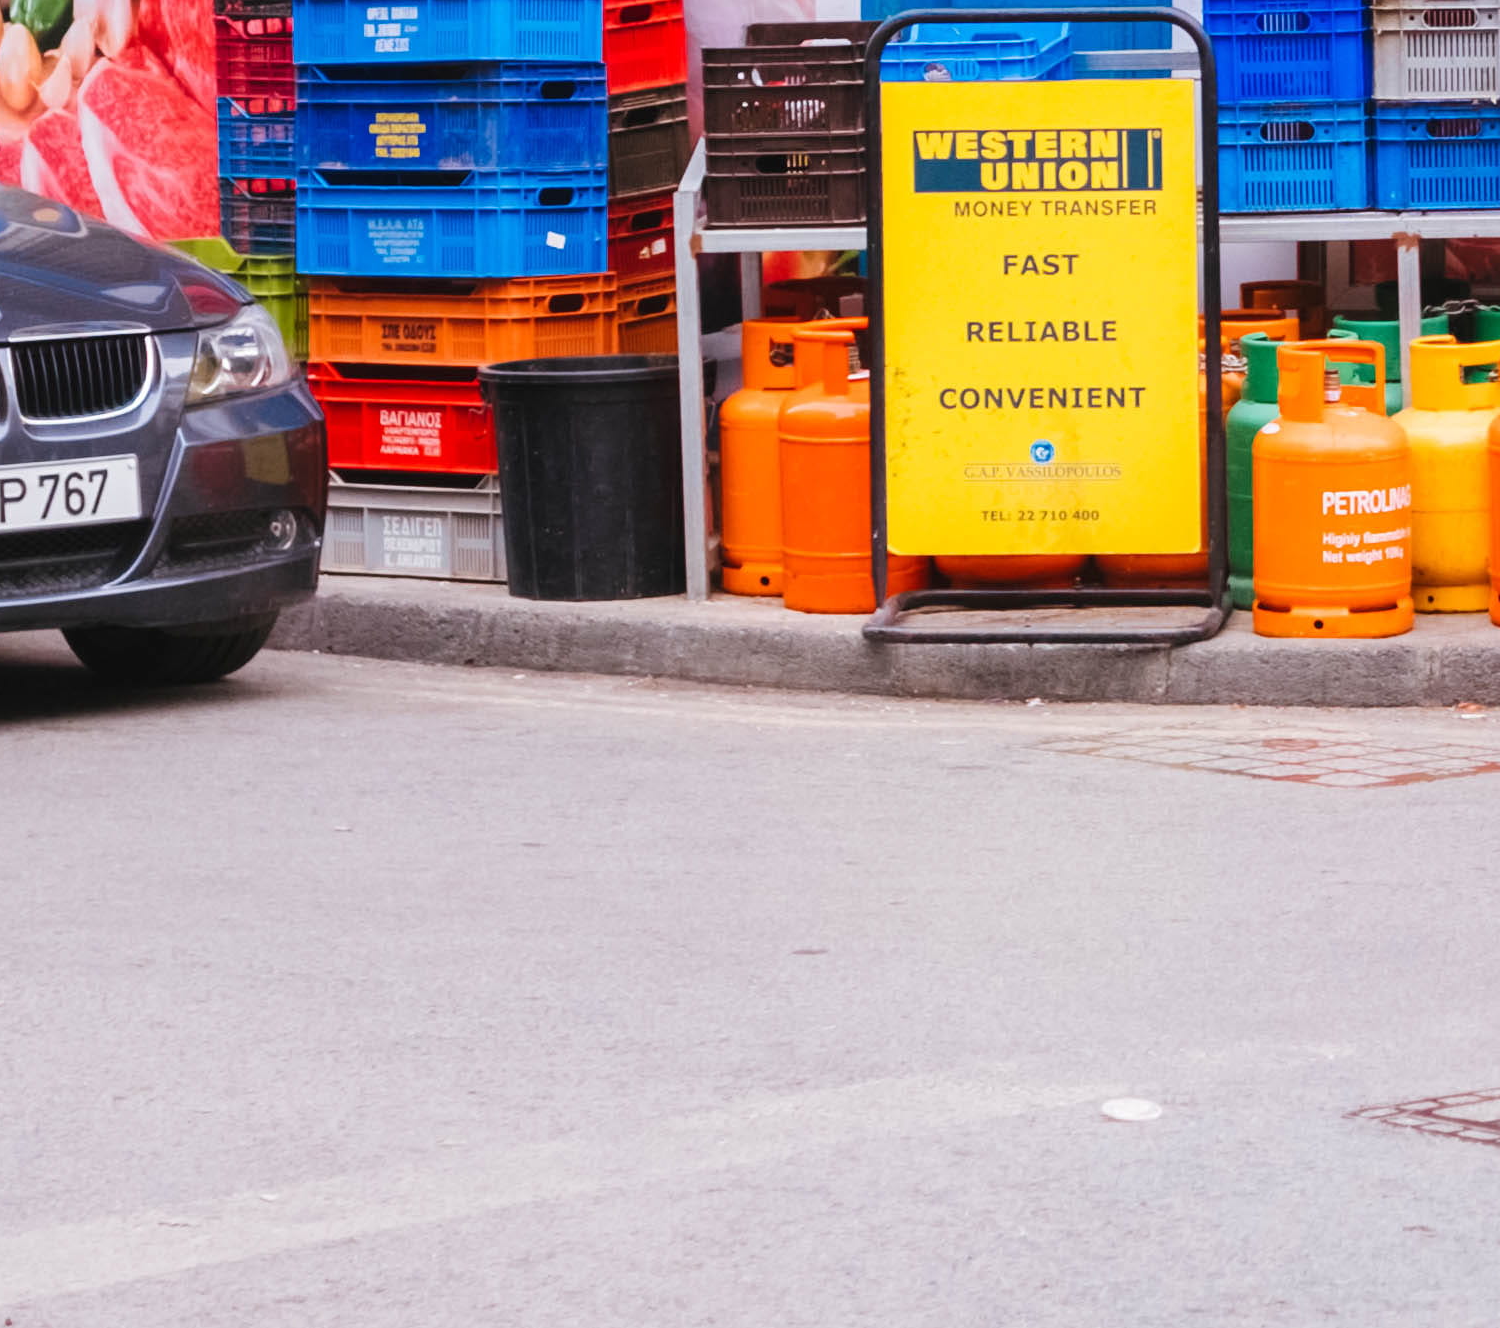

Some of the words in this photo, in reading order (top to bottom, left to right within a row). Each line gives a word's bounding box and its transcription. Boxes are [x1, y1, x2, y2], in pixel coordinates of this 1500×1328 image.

[915, 130, 1119, 160] WESTERN
[980, 160, 1119, 191] UNION
[954, 200, 1032, 217] MONEY
[1041, 199, 1157, 216] TRANSFER
[1003, 254, 1079, 275] FAST
[966, 320, 1117, 342] RELIABLE
[939, 387, 1146, 409] CONVENIENT
[380, 409, 442, 429] ΒΑΓΙΑΝΟΣ
[1006, 465, 1122, 479] VASSILOPOULOS
[38, 469, 108, 520] 767
[1017, 510, 1035, 521] 22
[1041, 510, 1068, 521] 710
[1072, 510, 1100, 521] 400
[1322, 532, 1361, 548] Highly
[1322, 549, 1344, 563] Net
